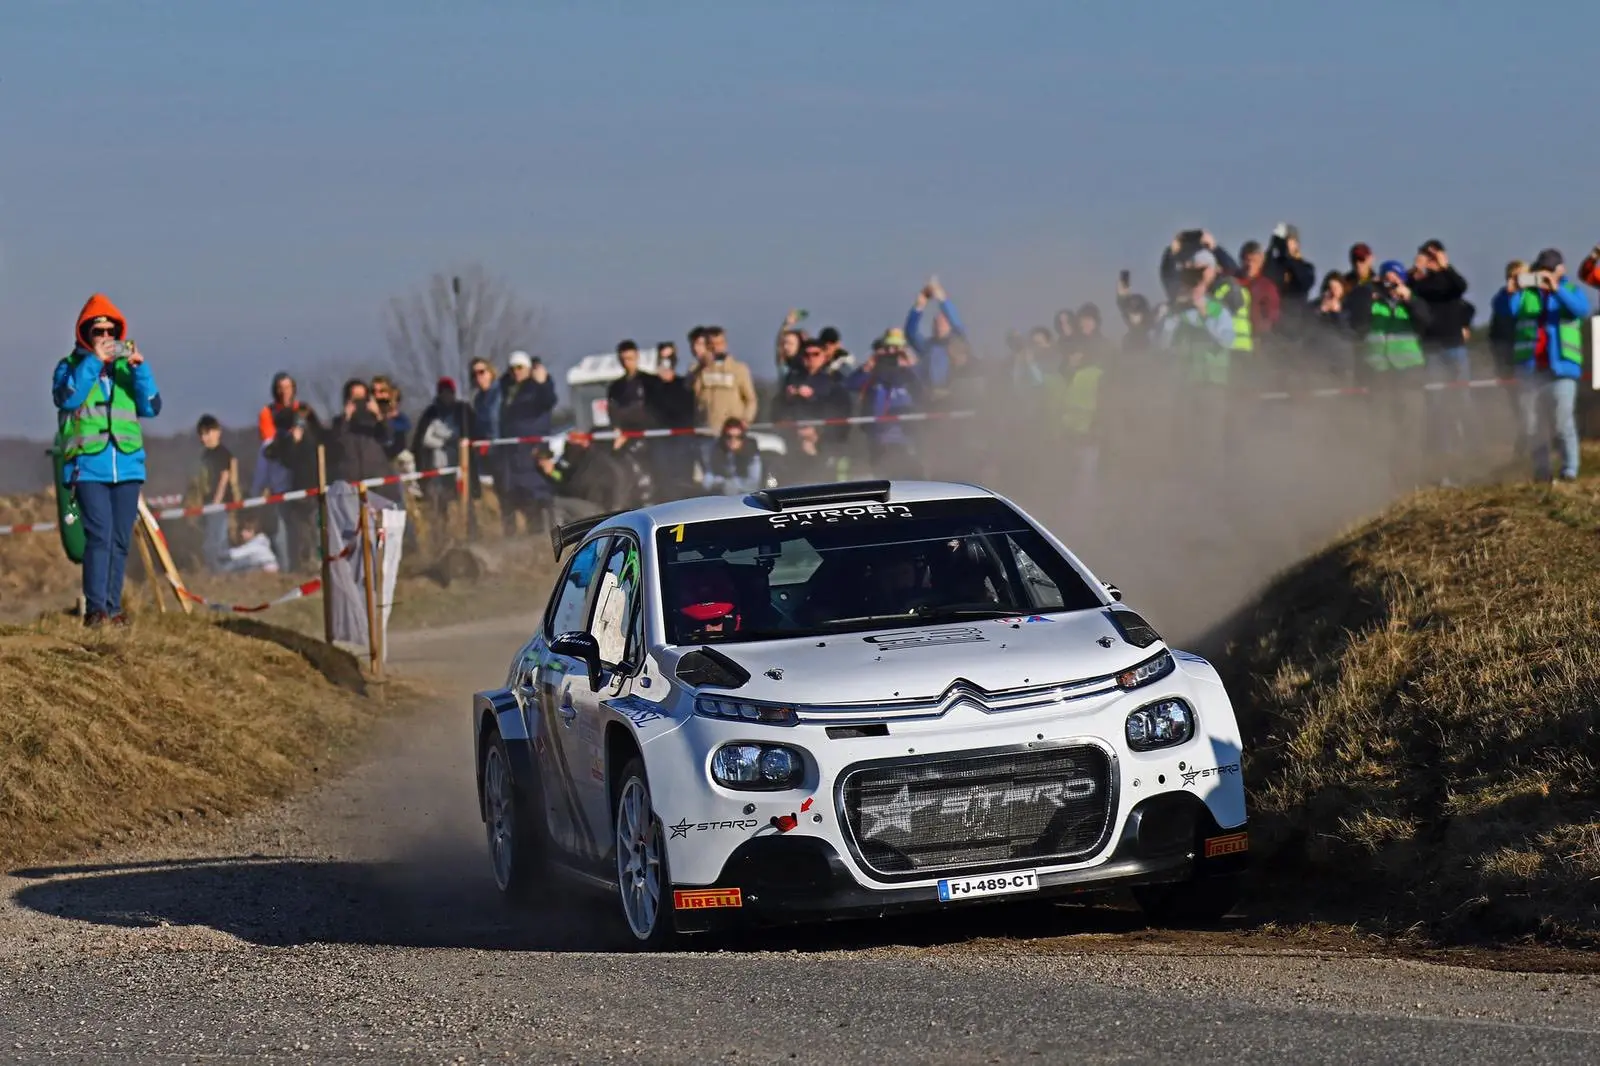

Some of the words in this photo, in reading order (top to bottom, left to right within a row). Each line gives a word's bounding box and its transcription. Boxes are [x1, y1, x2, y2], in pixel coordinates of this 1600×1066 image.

[768, 505, 910, 523] CITROËN
[669, 524, 685, 543] 1
[1202, 764, 1239, 777] STARD
[697, 819, 758, 831] STARD
[1205, 832, 1248, 858] PIRELLI
[951, 874, 1034, 894] FJ-489-CT
[674, 888, 742, 909] PIRELLI
